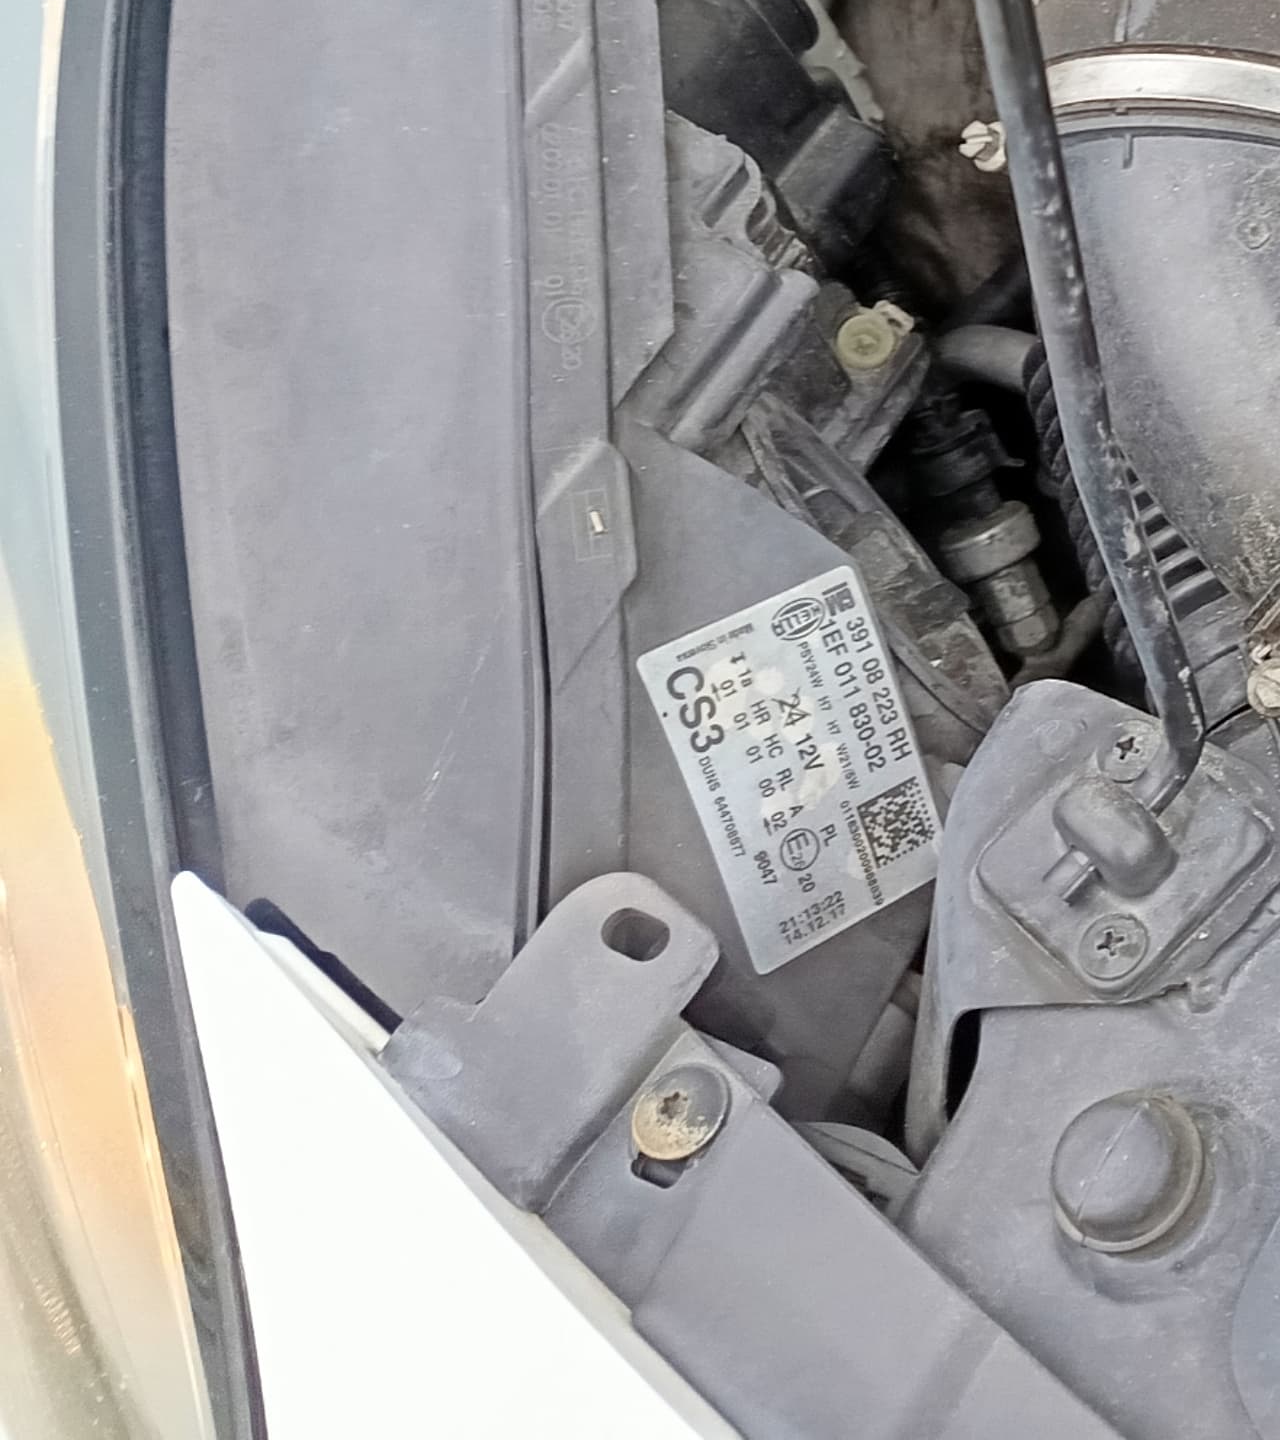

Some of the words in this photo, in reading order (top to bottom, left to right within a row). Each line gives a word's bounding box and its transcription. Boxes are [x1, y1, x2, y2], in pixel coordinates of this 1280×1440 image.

[772, 608, 818, 636] HELLA
[846, 616, 873, 652] 391
[862, 657, 883, 684] 08
[666, 666, 724, 752] CS3
[819, 619, 847, 655] 1EF
[834, 661, 859, 699] 011
[849, 702, 885, 773] 830-02
[872, 687, 897, 724] 223
[817, 695, 832, 710] H7
[826, 719, 841, 734] H7
[719, 679, 737, 697] 01
[733, 712, 750, 730] 01
[745, 745, 763, 763] 01
[758, 778, 775, 797] 00
[771, 810, 787, 830] 02
[750, 700, 769, 725] HR
[763, 733, 784, 758] HC
[775, 767, 793, 790] RL
[788, 805, 803, 817] A
[795, 733, 823, 770] 12V
[886, 727, 911, 761] RH
[698, 755, 720, 791] DUNS
[819, 823, 837, 846] PL
[797, 873, 815, 892] 20
